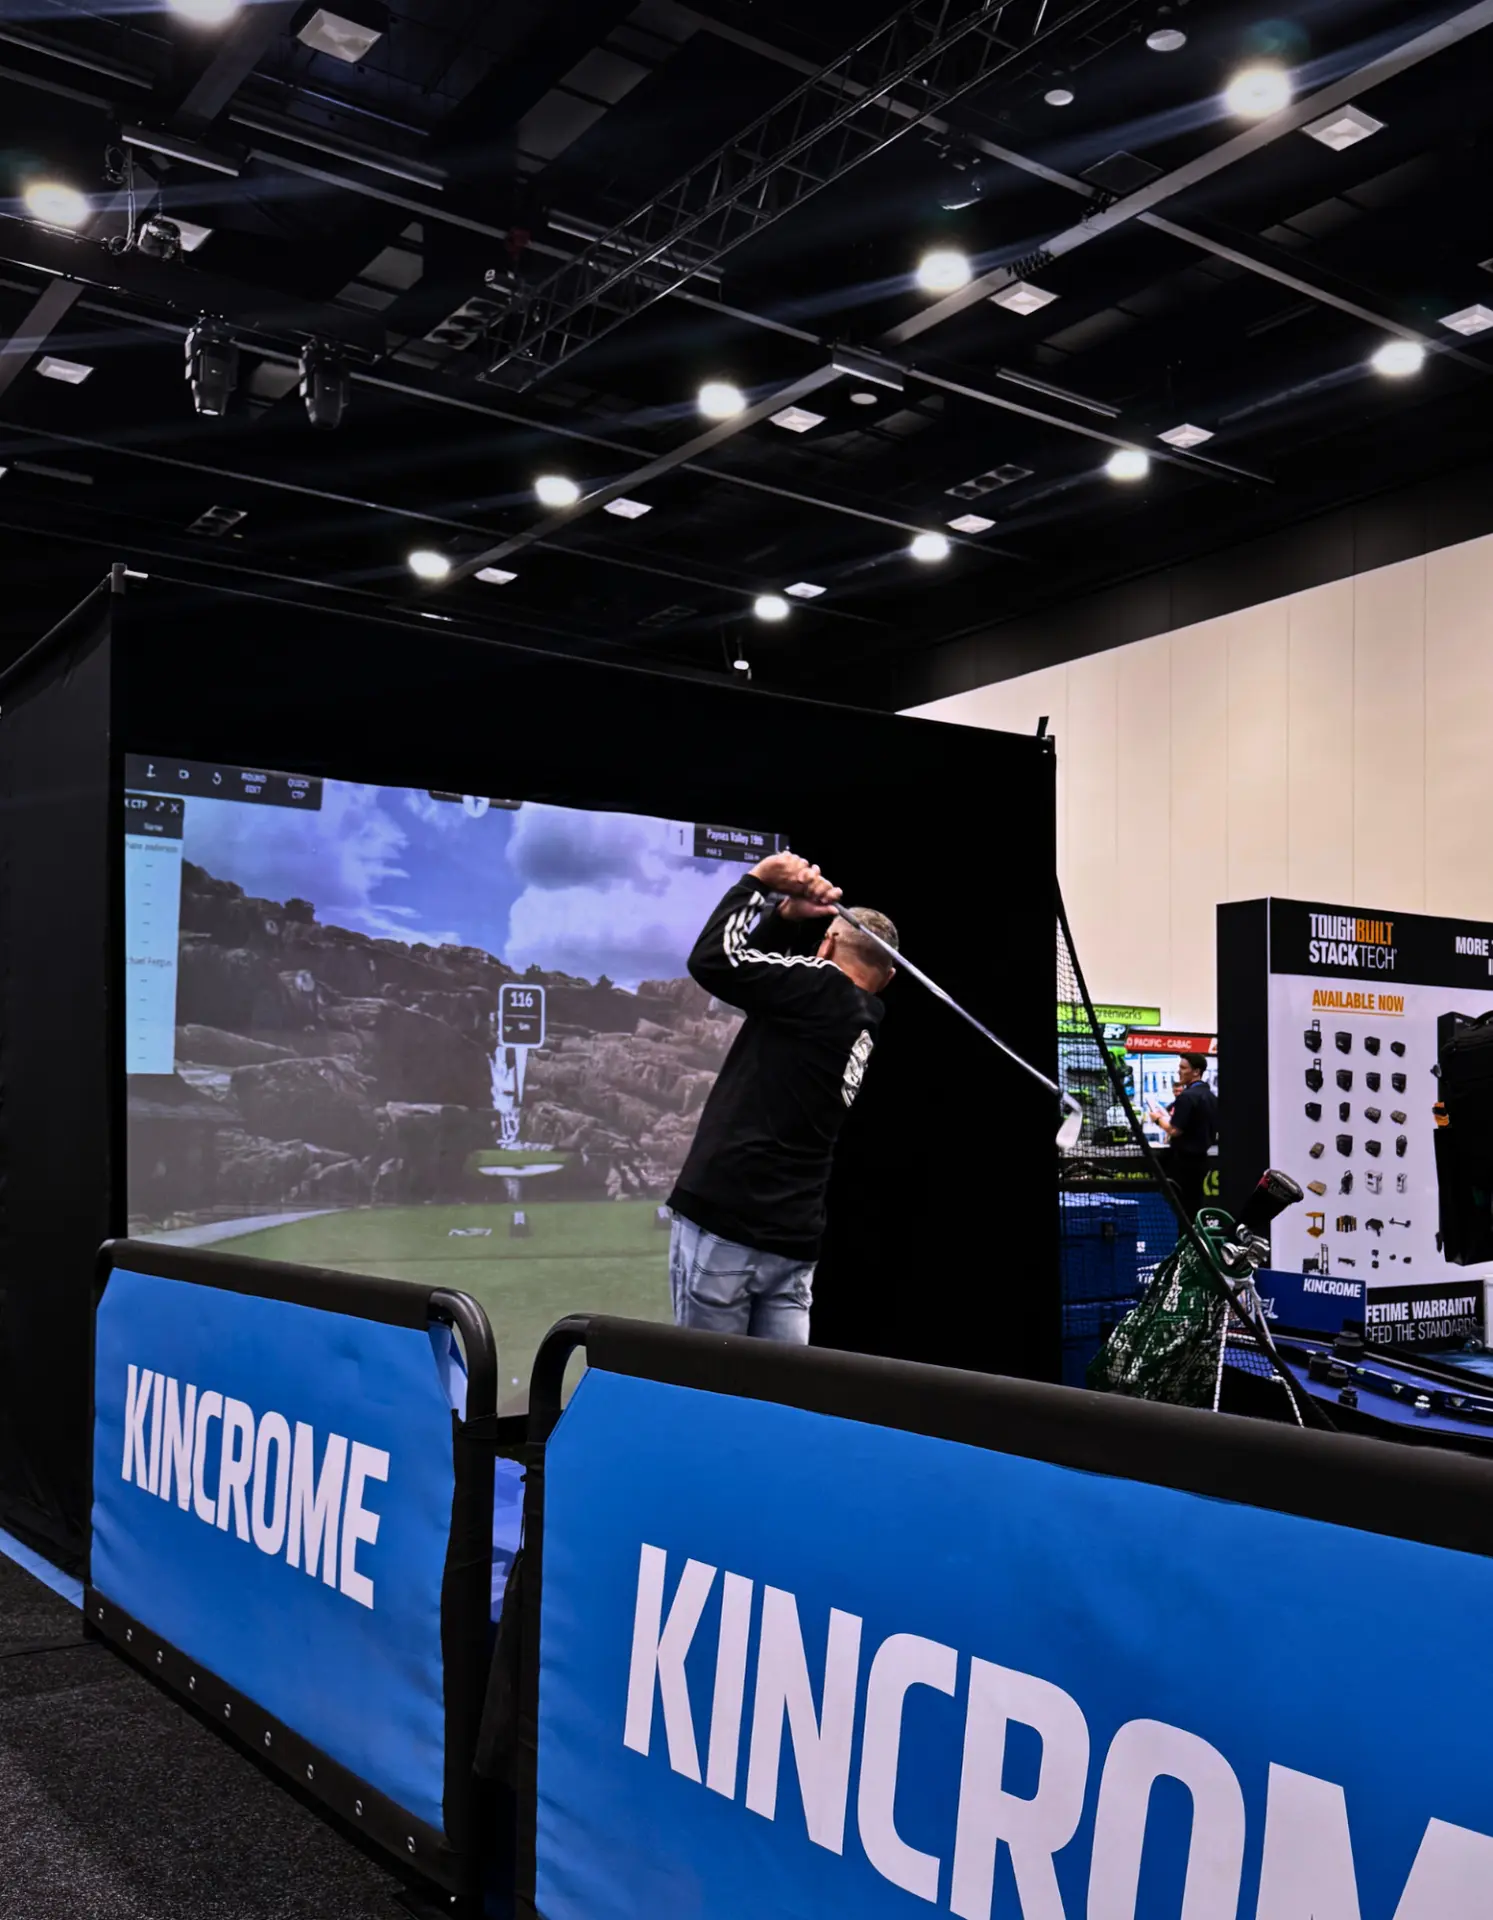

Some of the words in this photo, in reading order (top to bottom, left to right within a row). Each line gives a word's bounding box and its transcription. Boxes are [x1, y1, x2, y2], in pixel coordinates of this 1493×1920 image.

[1309, 913, 1394, 946] TOUGHBUILT
[1455, 936, 1489, 956] MORE
[510, 991, 533, 1008] 116
[1312, 989, 1375, 1010] AVAILABLE
[1378, 995, 1405, 1012] NOW
[1095, 1007, 1142, 1020] greenworks
[1134, 1037, 1162, 1048] PACIFIC
[1167, 1039, 1192, 1050] CABAC
[1303, 1278, 1362, 1298] KINCROME
[1365, 1302, 1409, 1324] FETIME
[1411, 1296, 1477, 1319] WARRANTY
[1395, 1322, 1416, 1341] THE
[1418, 1317, 1478, 1340] STANDARDS
[122, 1364, 390, 1610] KINCROME
